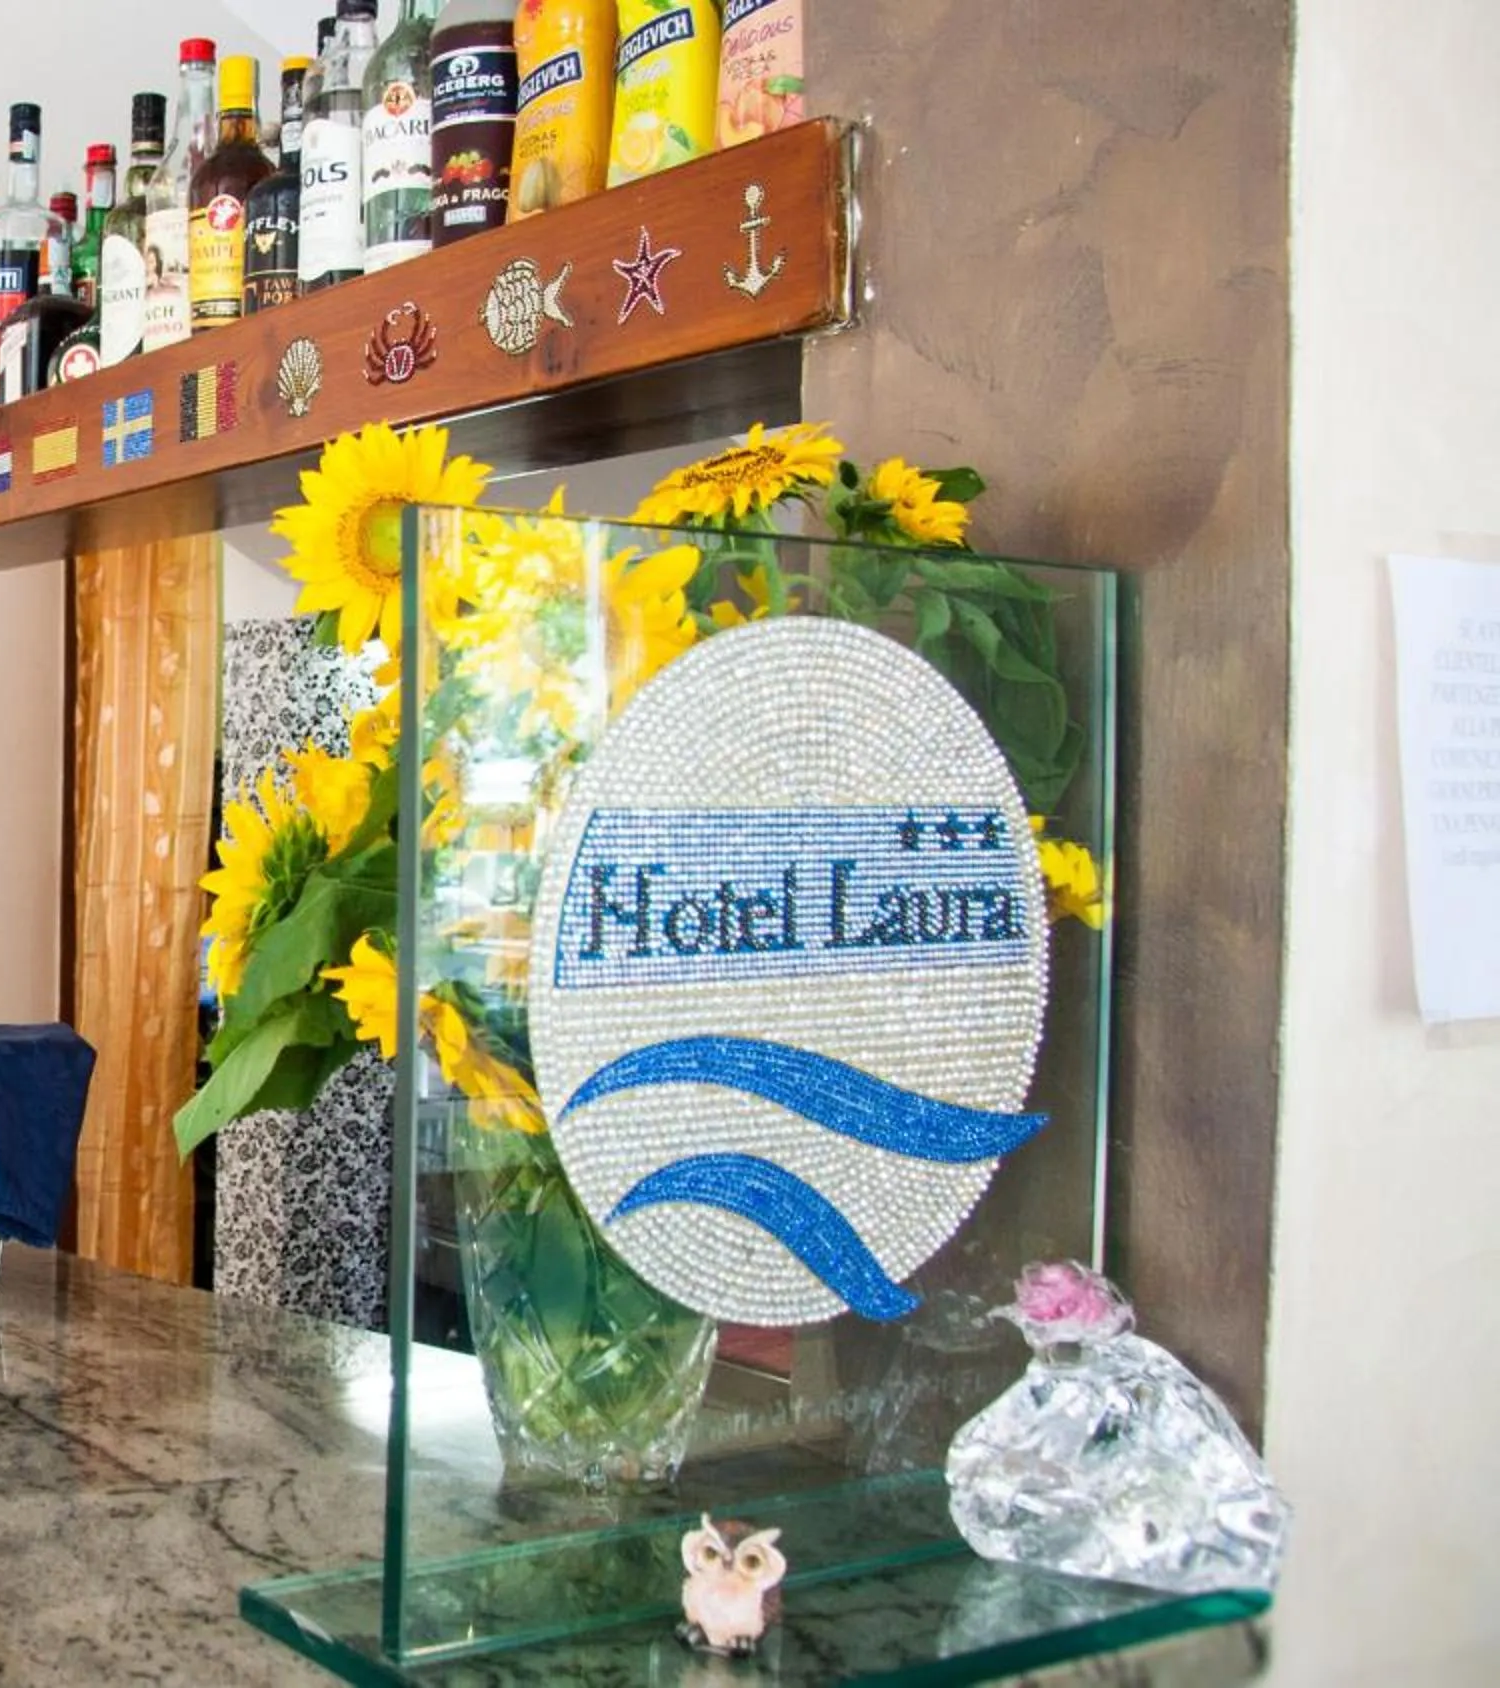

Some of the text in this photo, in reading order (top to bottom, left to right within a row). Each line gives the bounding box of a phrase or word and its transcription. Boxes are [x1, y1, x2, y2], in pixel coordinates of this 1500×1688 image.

[303, 161, 348, 189] OLS
[263, 278, 294, 291] TAW
[578, 858, 1031, 962] Hotel Laura
